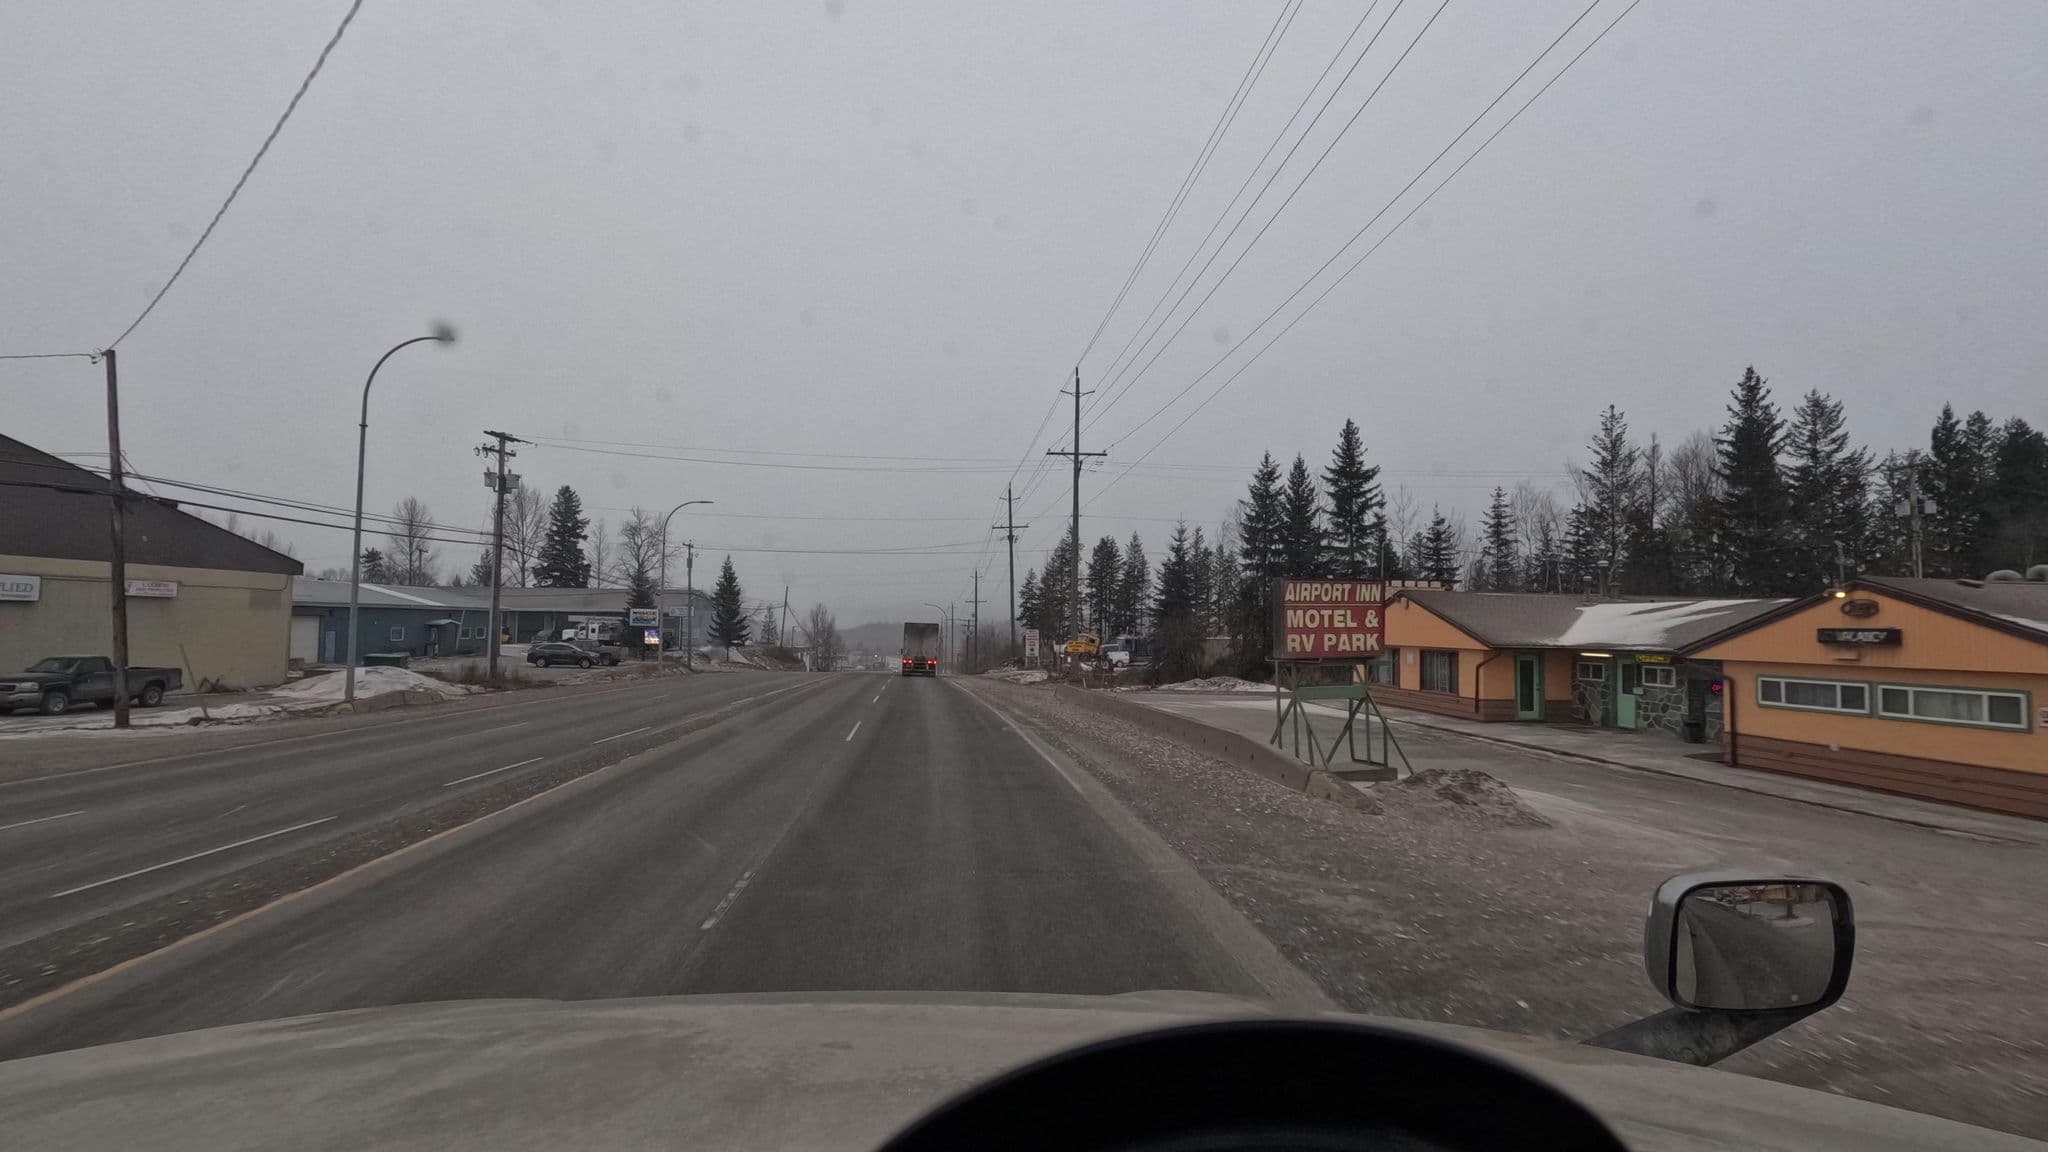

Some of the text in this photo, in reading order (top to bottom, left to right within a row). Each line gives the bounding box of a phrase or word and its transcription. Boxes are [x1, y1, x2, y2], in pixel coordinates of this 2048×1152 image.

[1284, 583, 1382, 602] AIRPORT INN
[1287, 609, 1380, 629] MOTEL &
[1287, 633, 1380, 652] RV PARK
